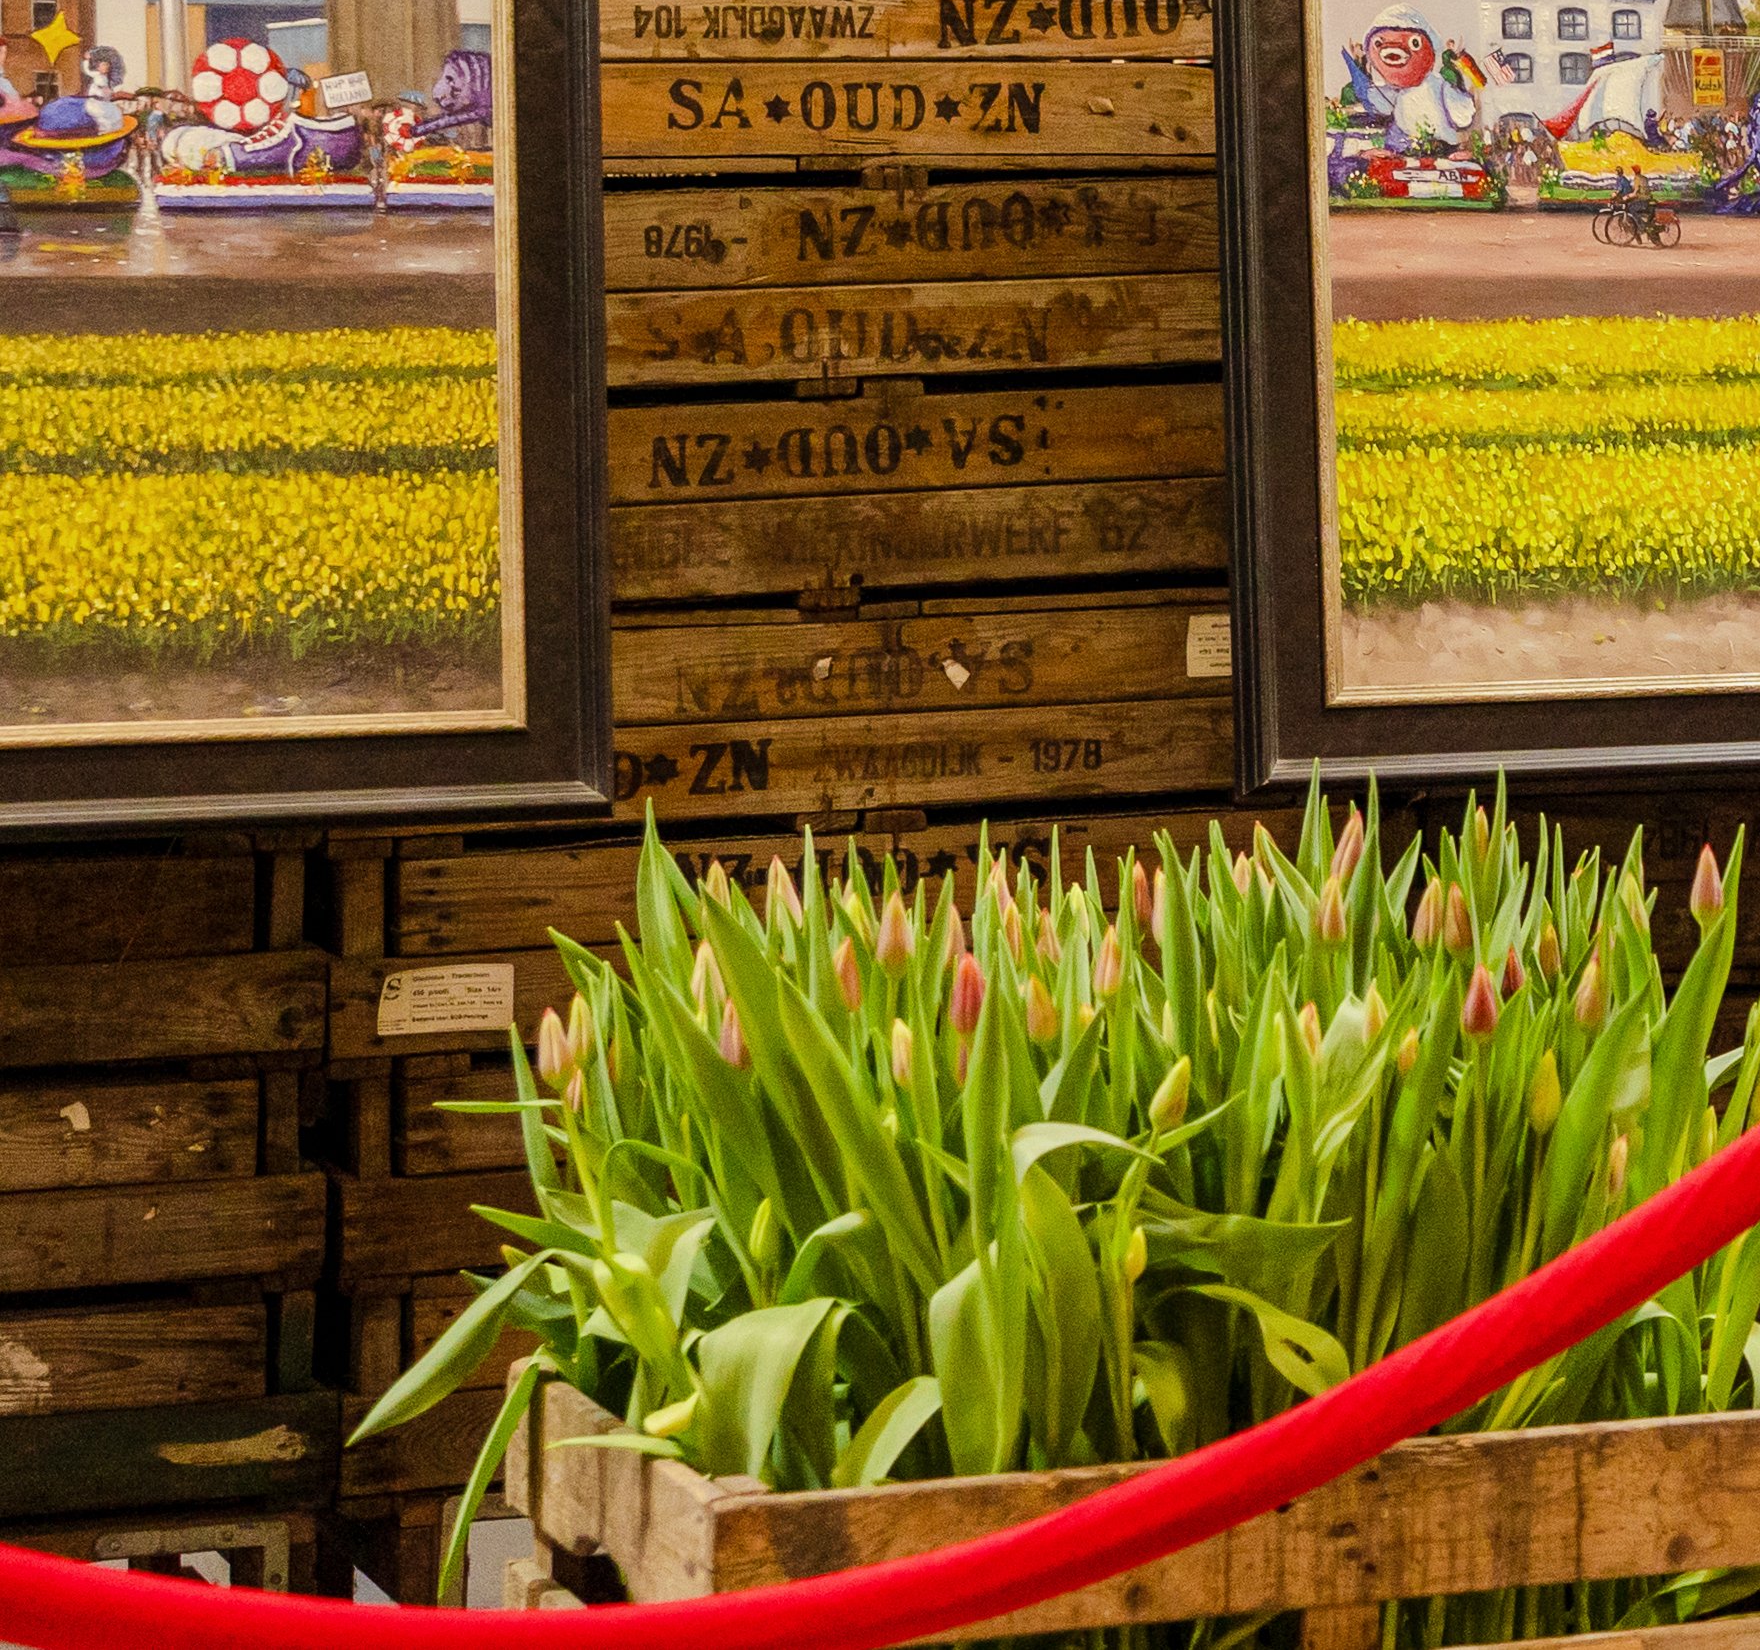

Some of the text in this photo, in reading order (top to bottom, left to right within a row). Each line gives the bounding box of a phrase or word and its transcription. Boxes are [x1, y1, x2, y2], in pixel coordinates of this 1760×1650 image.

[632, 4, 688, 41] 104
[667, 76, 1047, 135] SA OUD ZN
[648, 414, 1027, 489] SA OUD ZN
[688, 736, 774, 795] ZN
[1031, 739, 1102, 775] 1978
